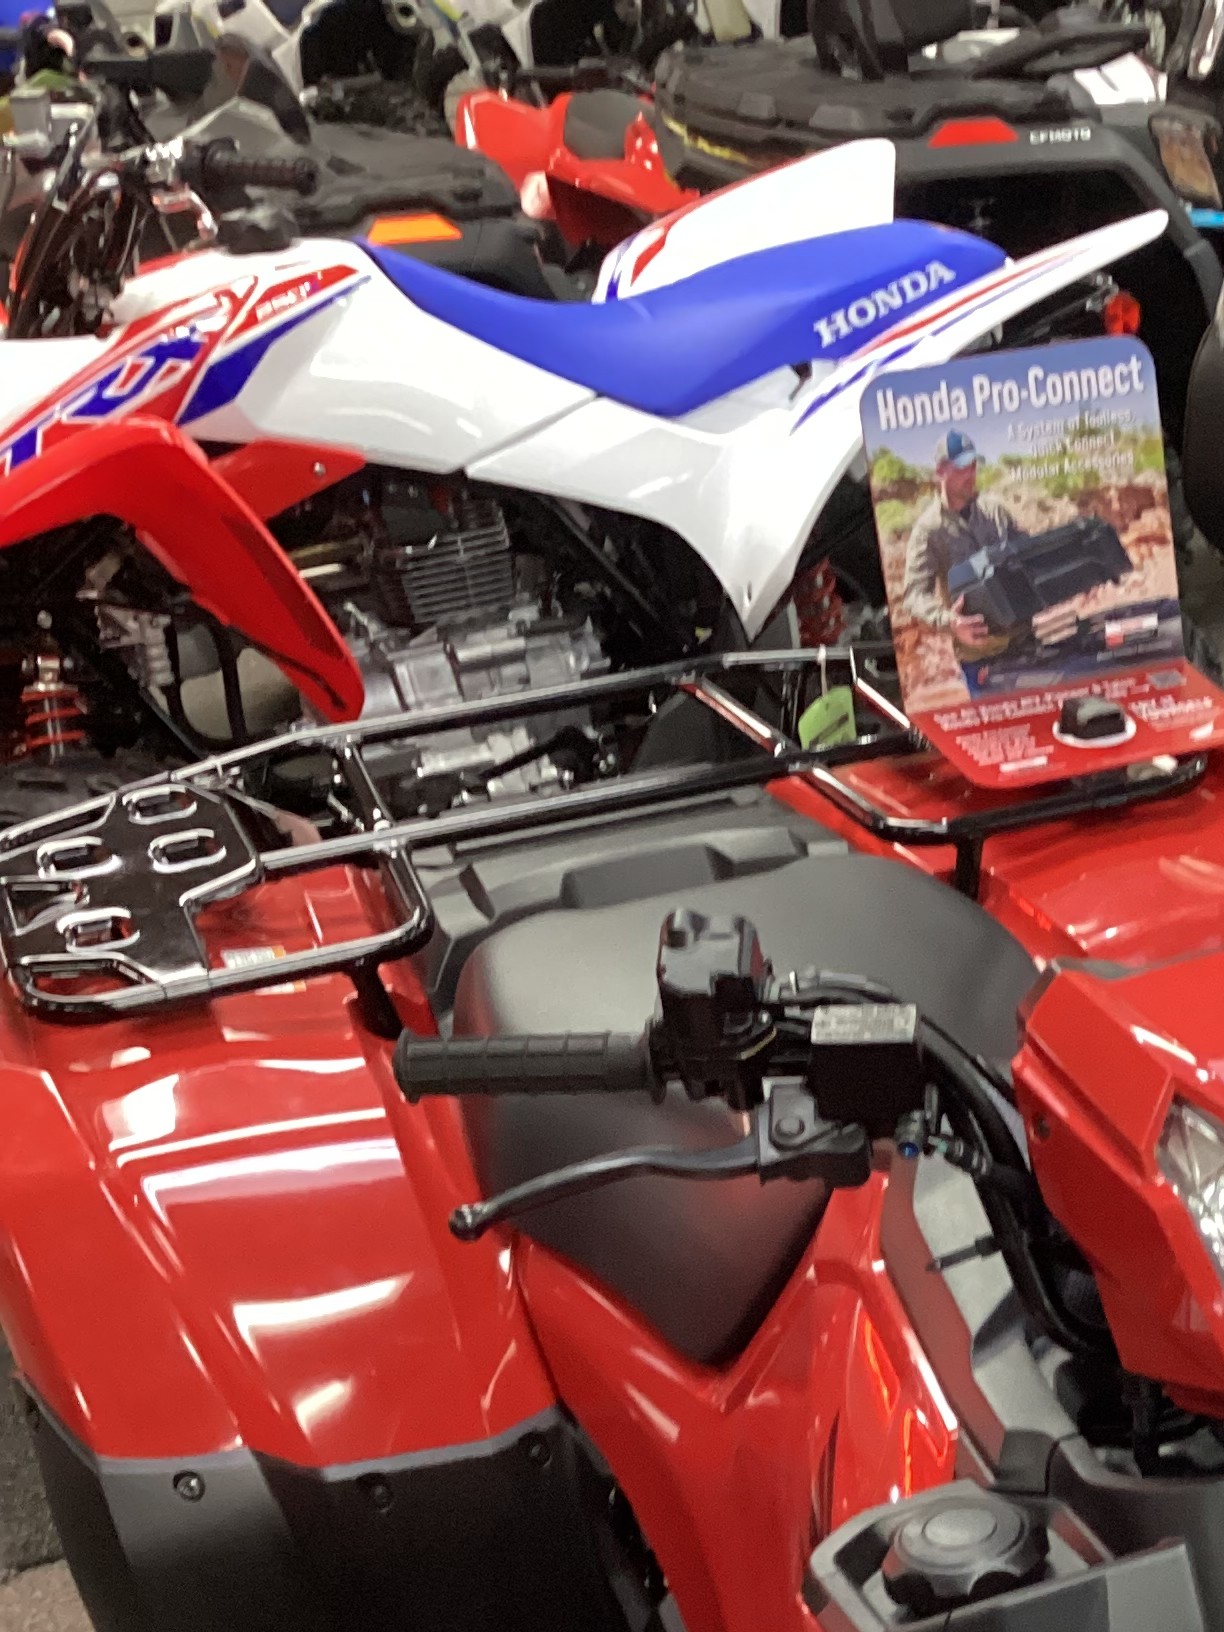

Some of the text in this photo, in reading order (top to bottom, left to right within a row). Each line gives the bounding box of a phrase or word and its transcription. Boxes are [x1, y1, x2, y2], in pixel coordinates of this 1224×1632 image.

[813, 260, 957, 348] HONDA
[876, 354, 1145, 431] Honda Pro-Connect
